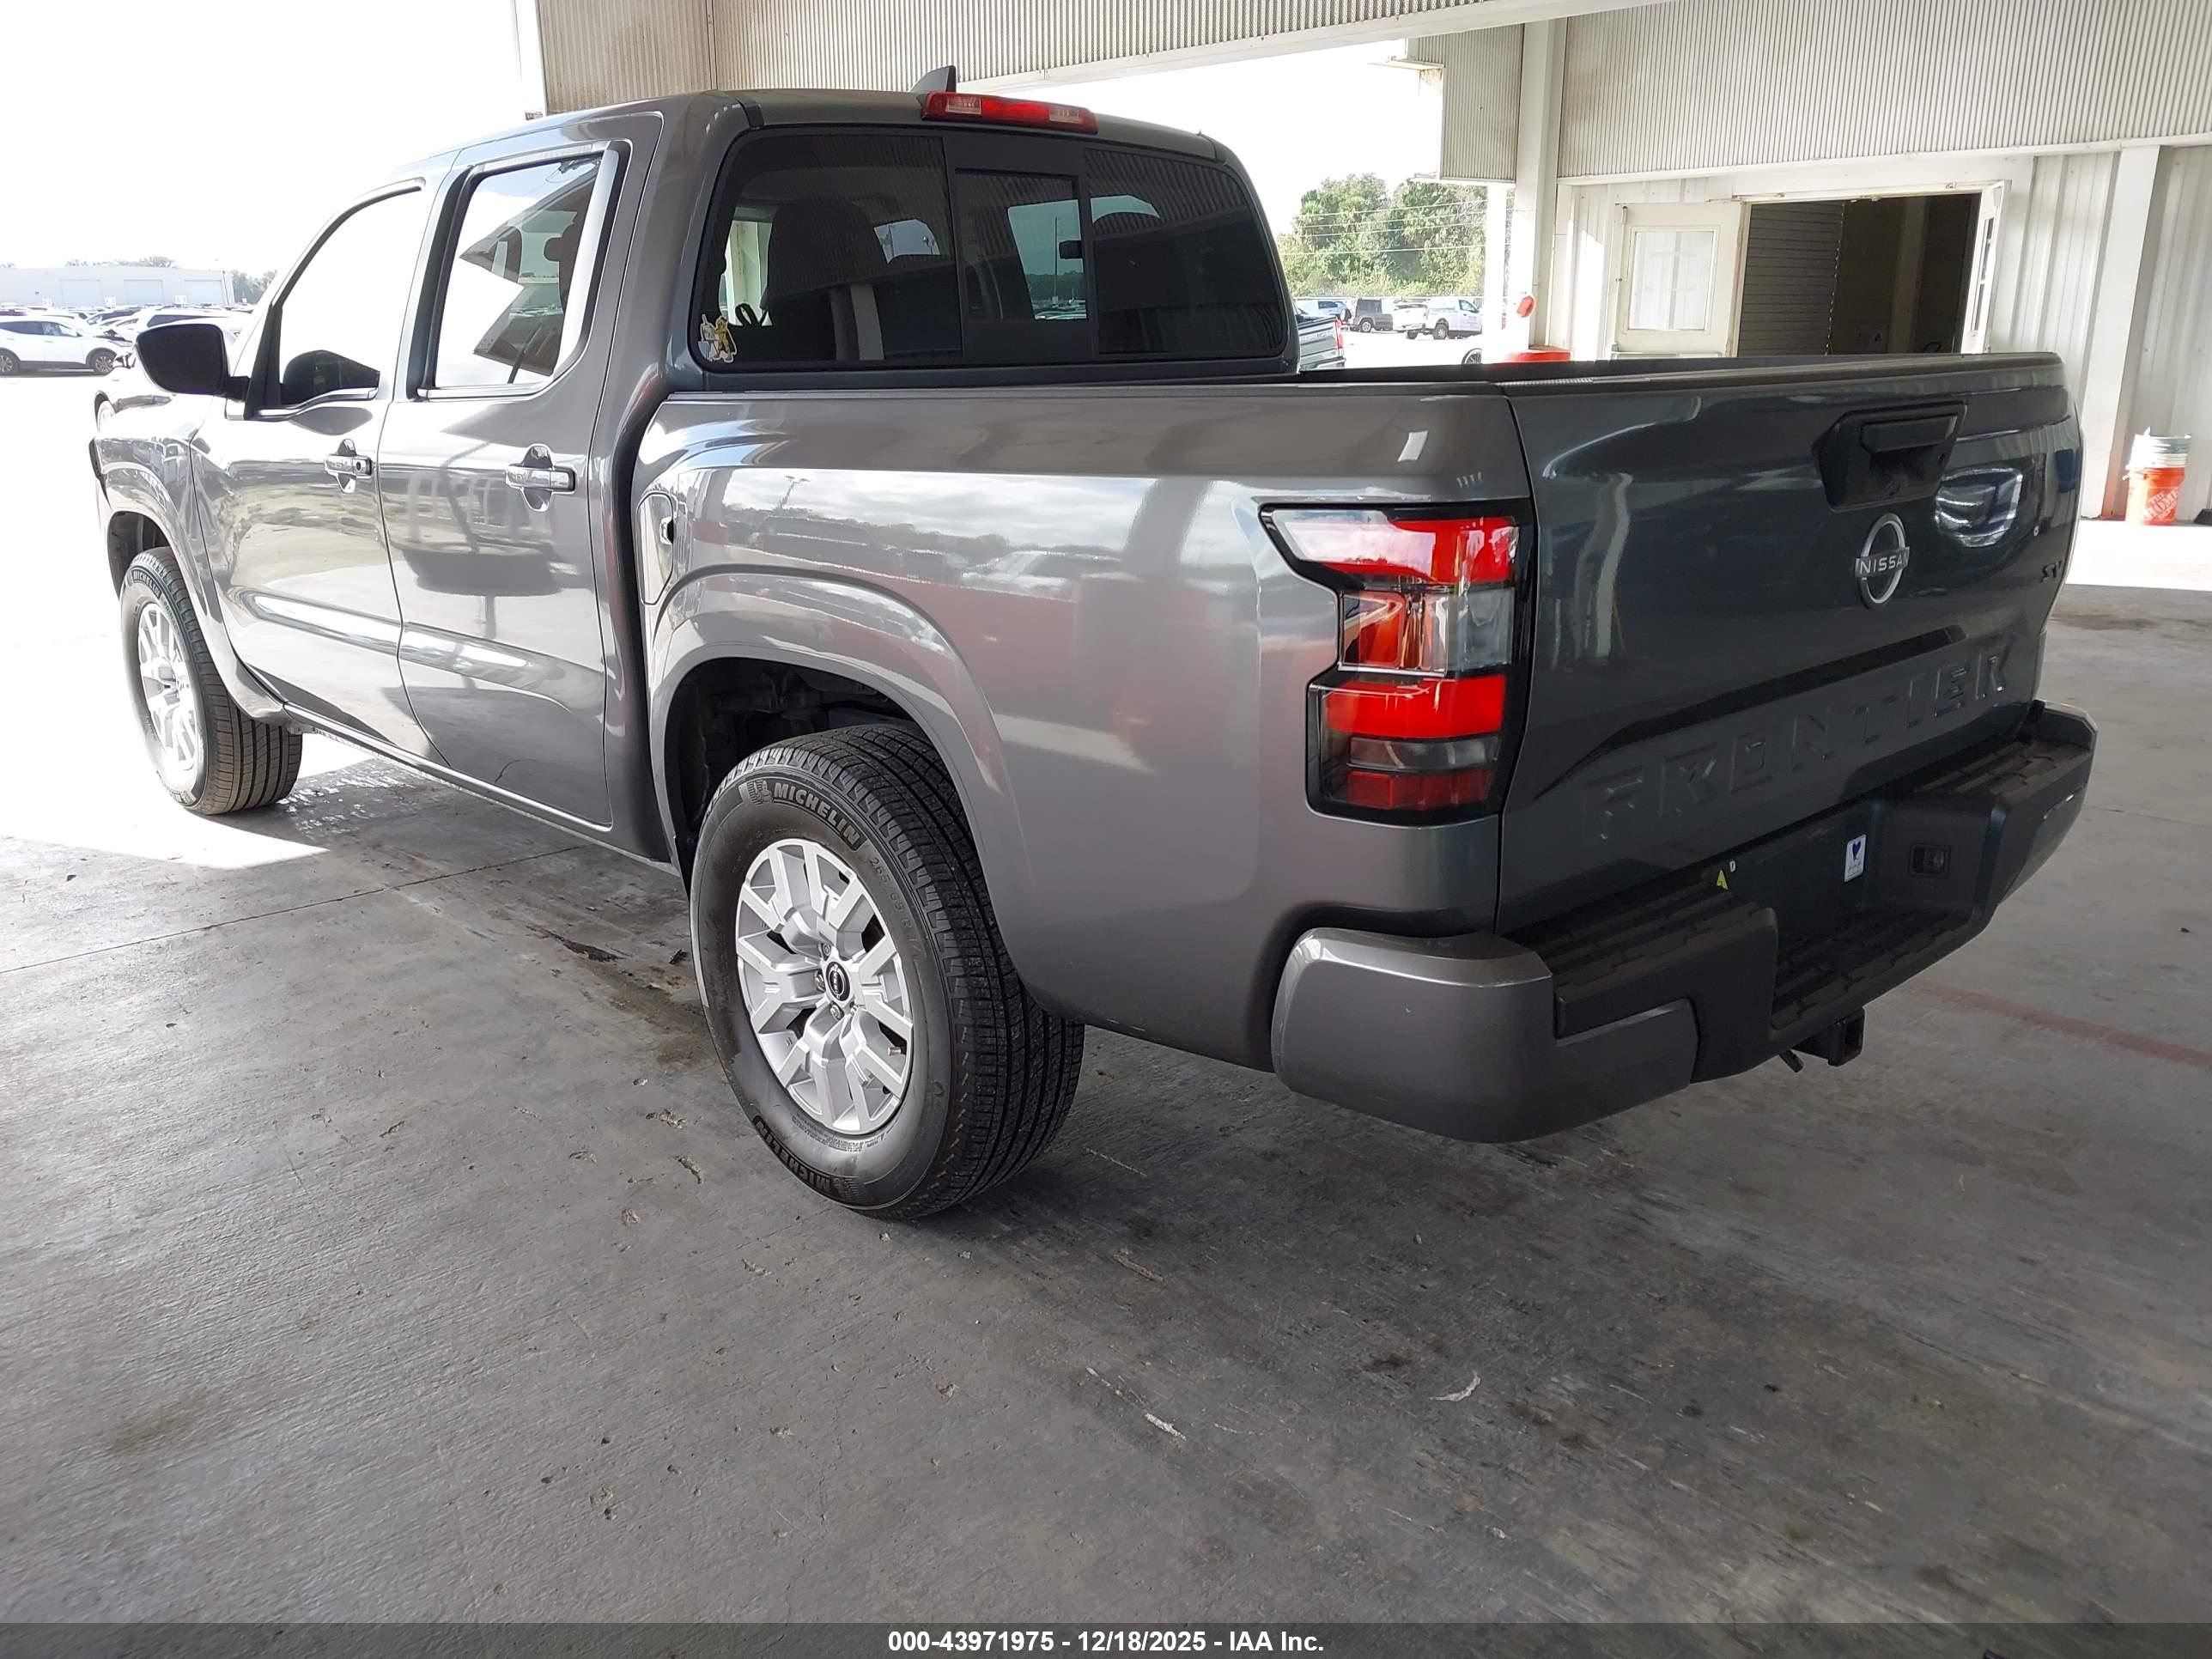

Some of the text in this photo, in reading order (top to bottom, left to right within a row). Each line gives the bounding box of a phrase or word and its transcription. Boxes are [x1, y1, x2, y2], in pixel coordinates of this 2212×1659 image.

[133, 570, 161, 597] MICHELIN
[1859, 550, 1909, 575] NISSAN
[1582, 646, 2010, 848] FRONTIER
[775, 782, 860, 845] MICHELIN
